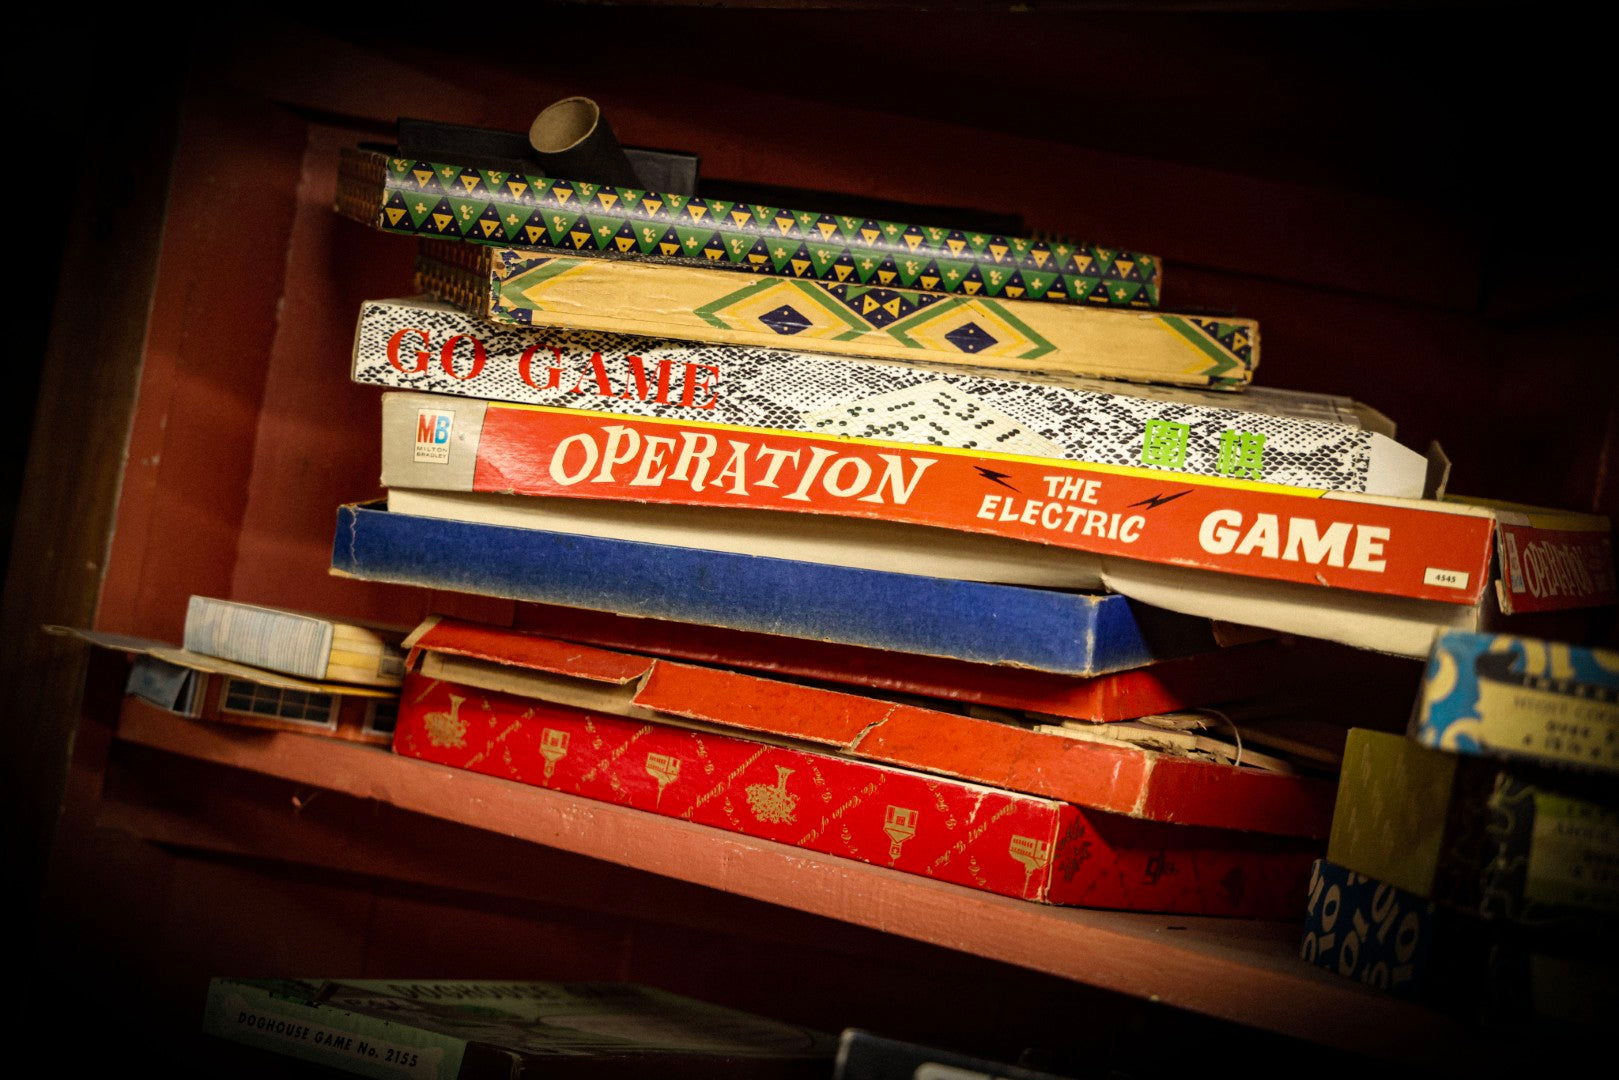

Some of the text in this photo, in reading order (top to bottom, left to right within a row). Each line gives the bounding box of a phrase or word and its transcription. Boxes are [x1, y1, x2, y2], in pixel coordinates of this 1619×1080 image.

[386, 328, 720, 410] GO GAME
[417, 414, 450, 445] MB
[549, 424, 939, 505] OPERATION
[1043, 475, 1102, 505] THE
[976, 494, 1146, 544] ELECTRIC
[1199, 508, 1391, 573] GAME
[1435, 574, 1456, 583] 4545
[238, 1011, 419, 1068] DOGHOUSE GAME No. 2155
